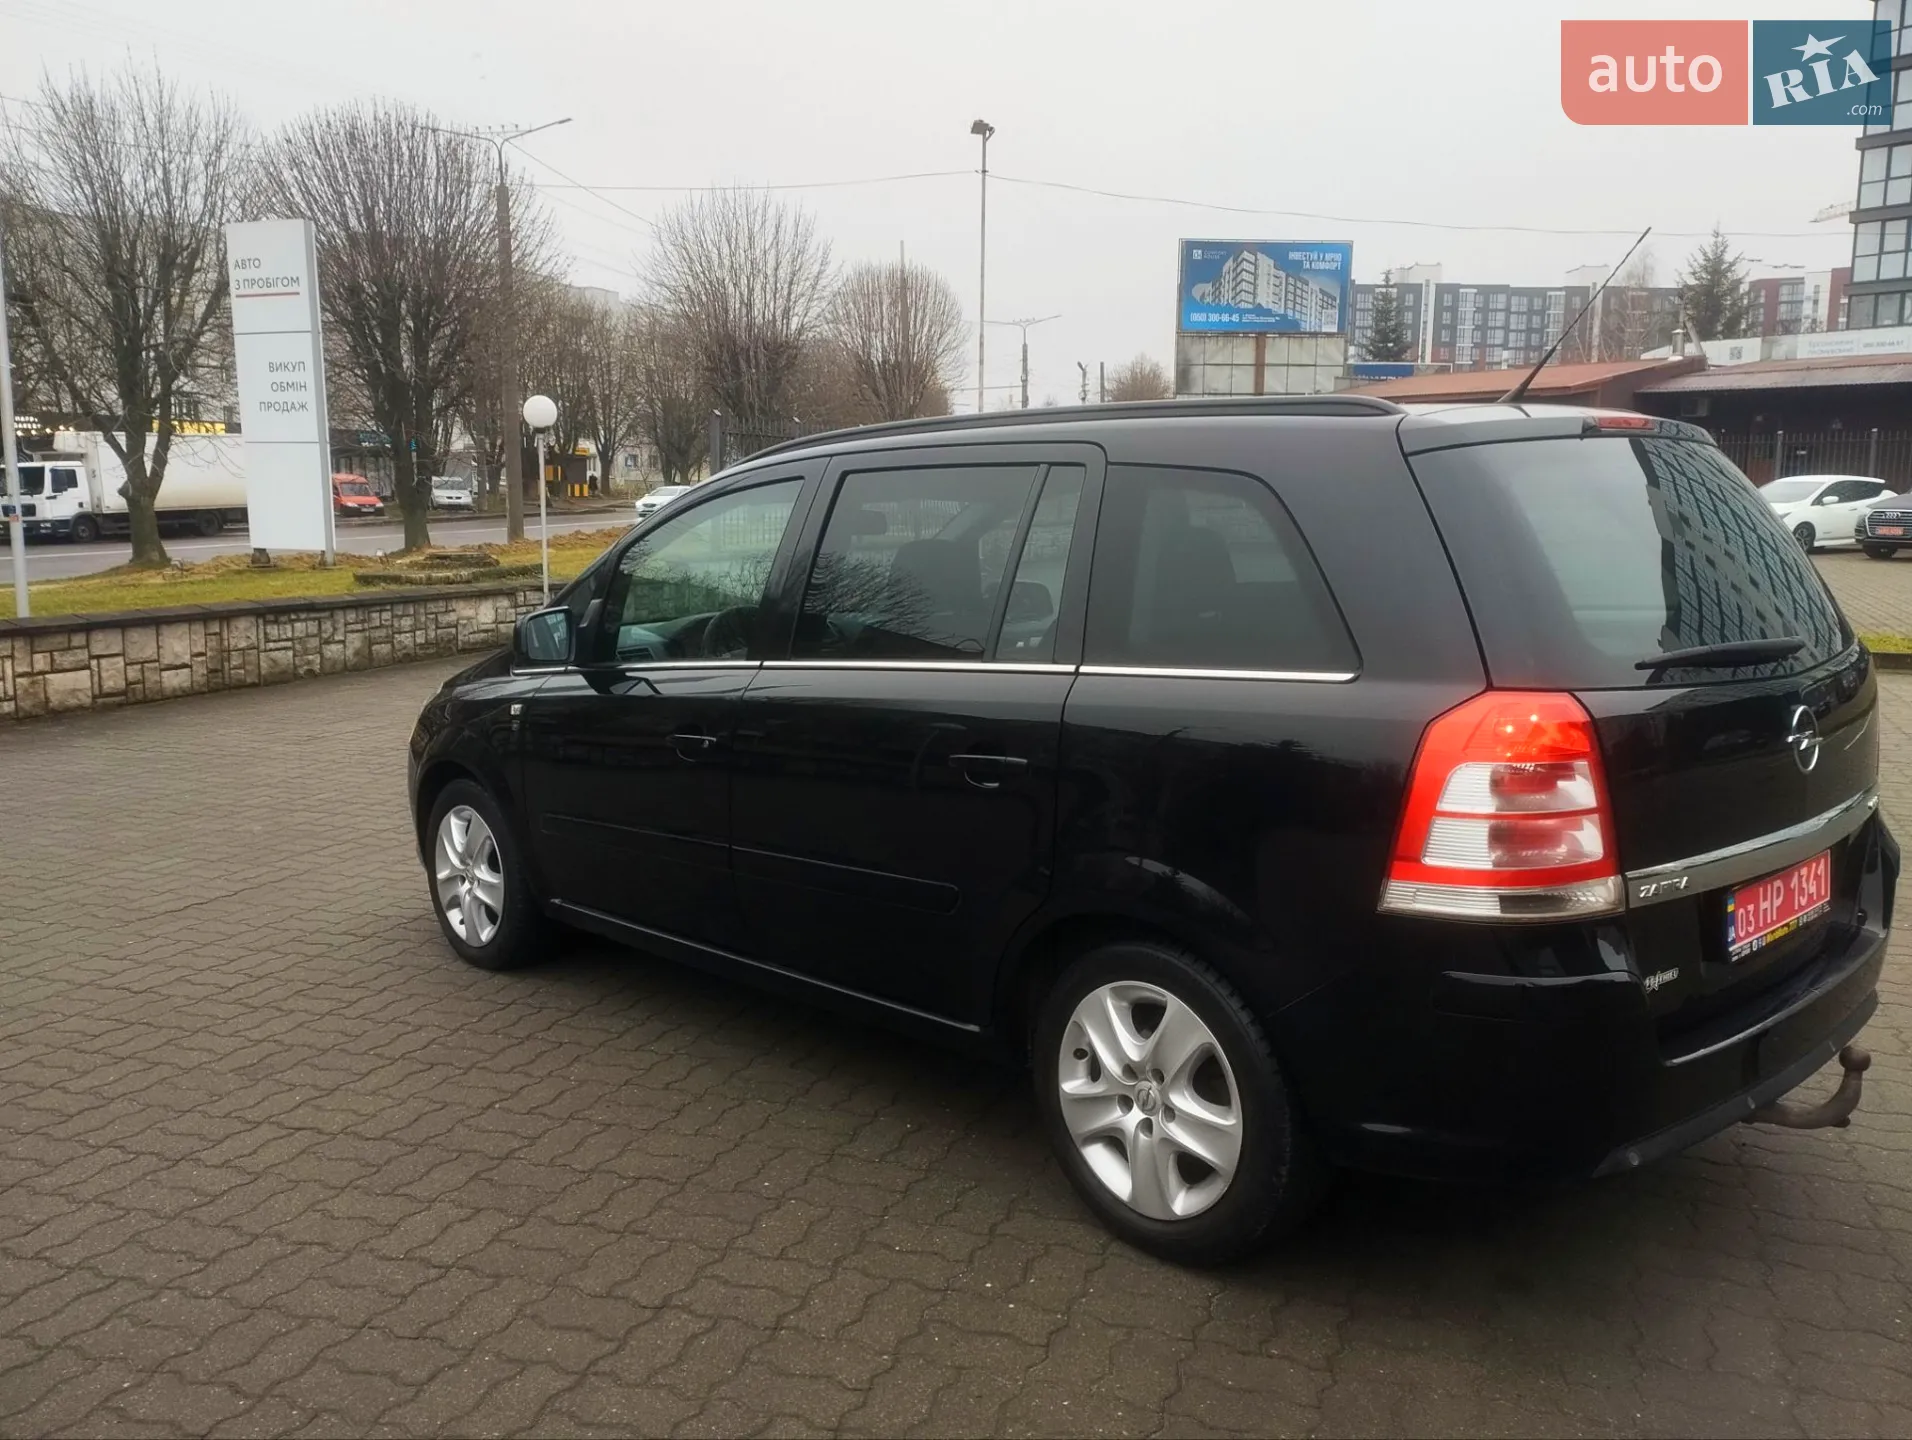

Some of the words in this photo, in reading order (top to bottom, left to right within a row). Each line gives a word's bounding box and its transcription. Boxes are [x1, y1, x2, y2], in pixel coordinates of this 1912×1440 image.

[234, 257, 262, 270] АВТО
[234, 279, 241, 290] З
[243, 276, 301, 290] ПРОБІГОМ
[268, 361, 306, 373] ВИКУП
[270, 381, 307, 392] ОБМІН
[259, 401, 309, 414] ПРОДАЖ
[1738, 903, 1756, 938] 03
[1759, 879, 1785, 928] HP
[1790, 858, 1826, 911] 1341
